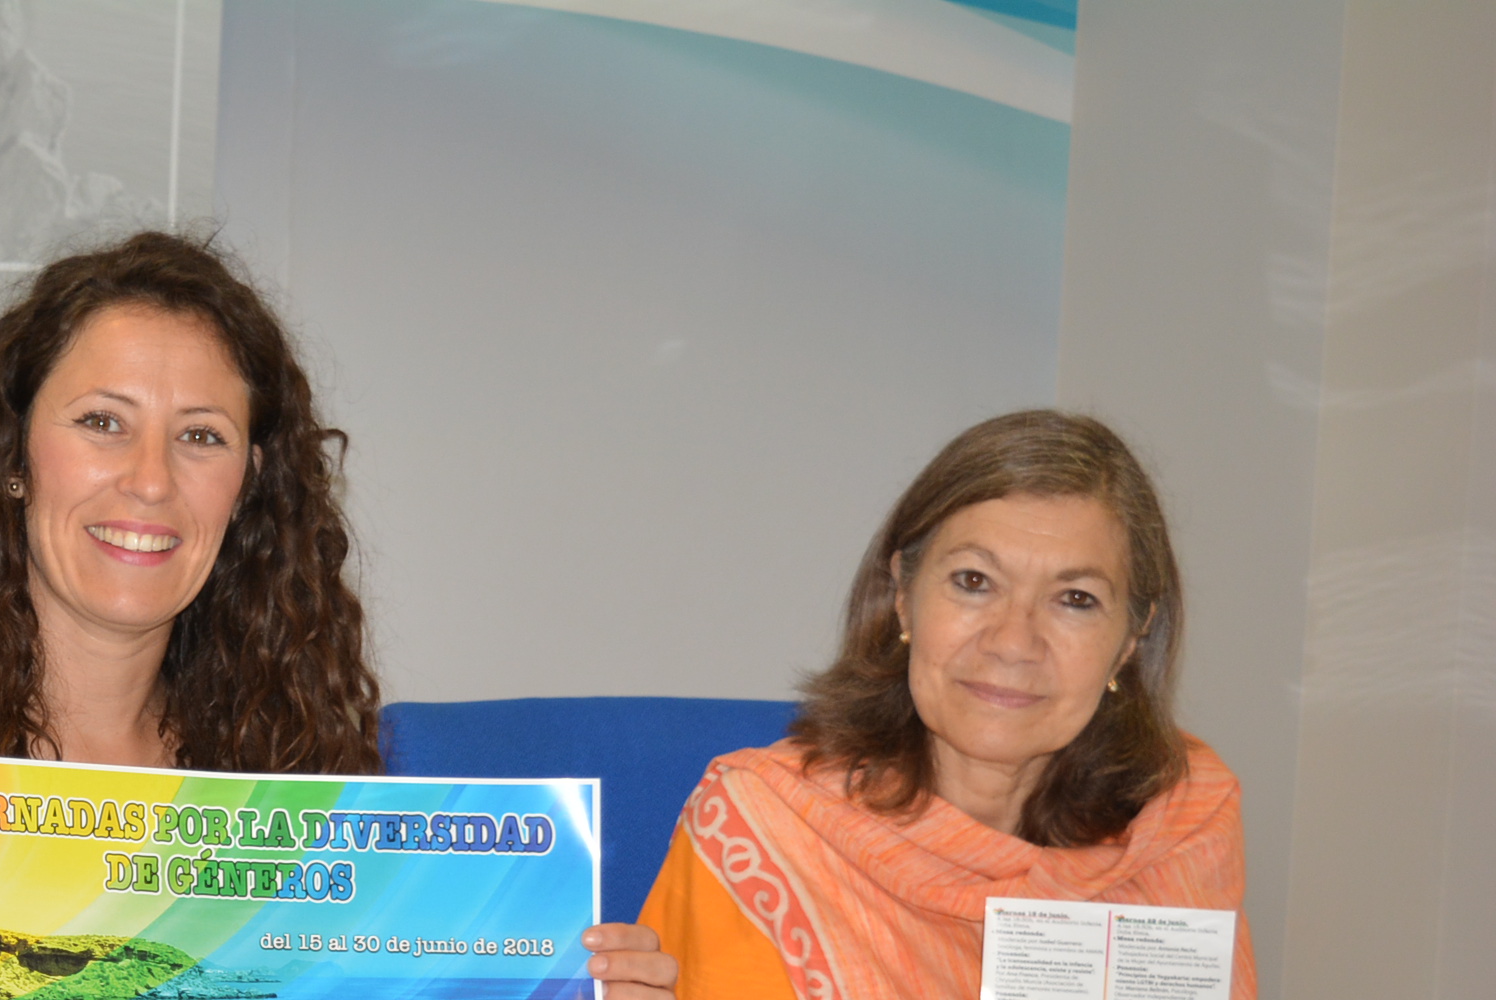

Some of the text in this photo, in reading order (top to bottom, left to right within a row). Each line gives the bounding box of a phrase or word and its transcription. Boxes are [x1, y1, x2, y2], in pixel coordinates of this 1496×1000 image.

[153, 804, 231, 847] POR
[237, 810, 296, 849] LA
[302, 812, 554, 853] DIVERSIDAD
[105, 848, 354, 902] DE GÉNEROS
[259, 933, 554, 957] del 15 al 30 de junio de 2018
